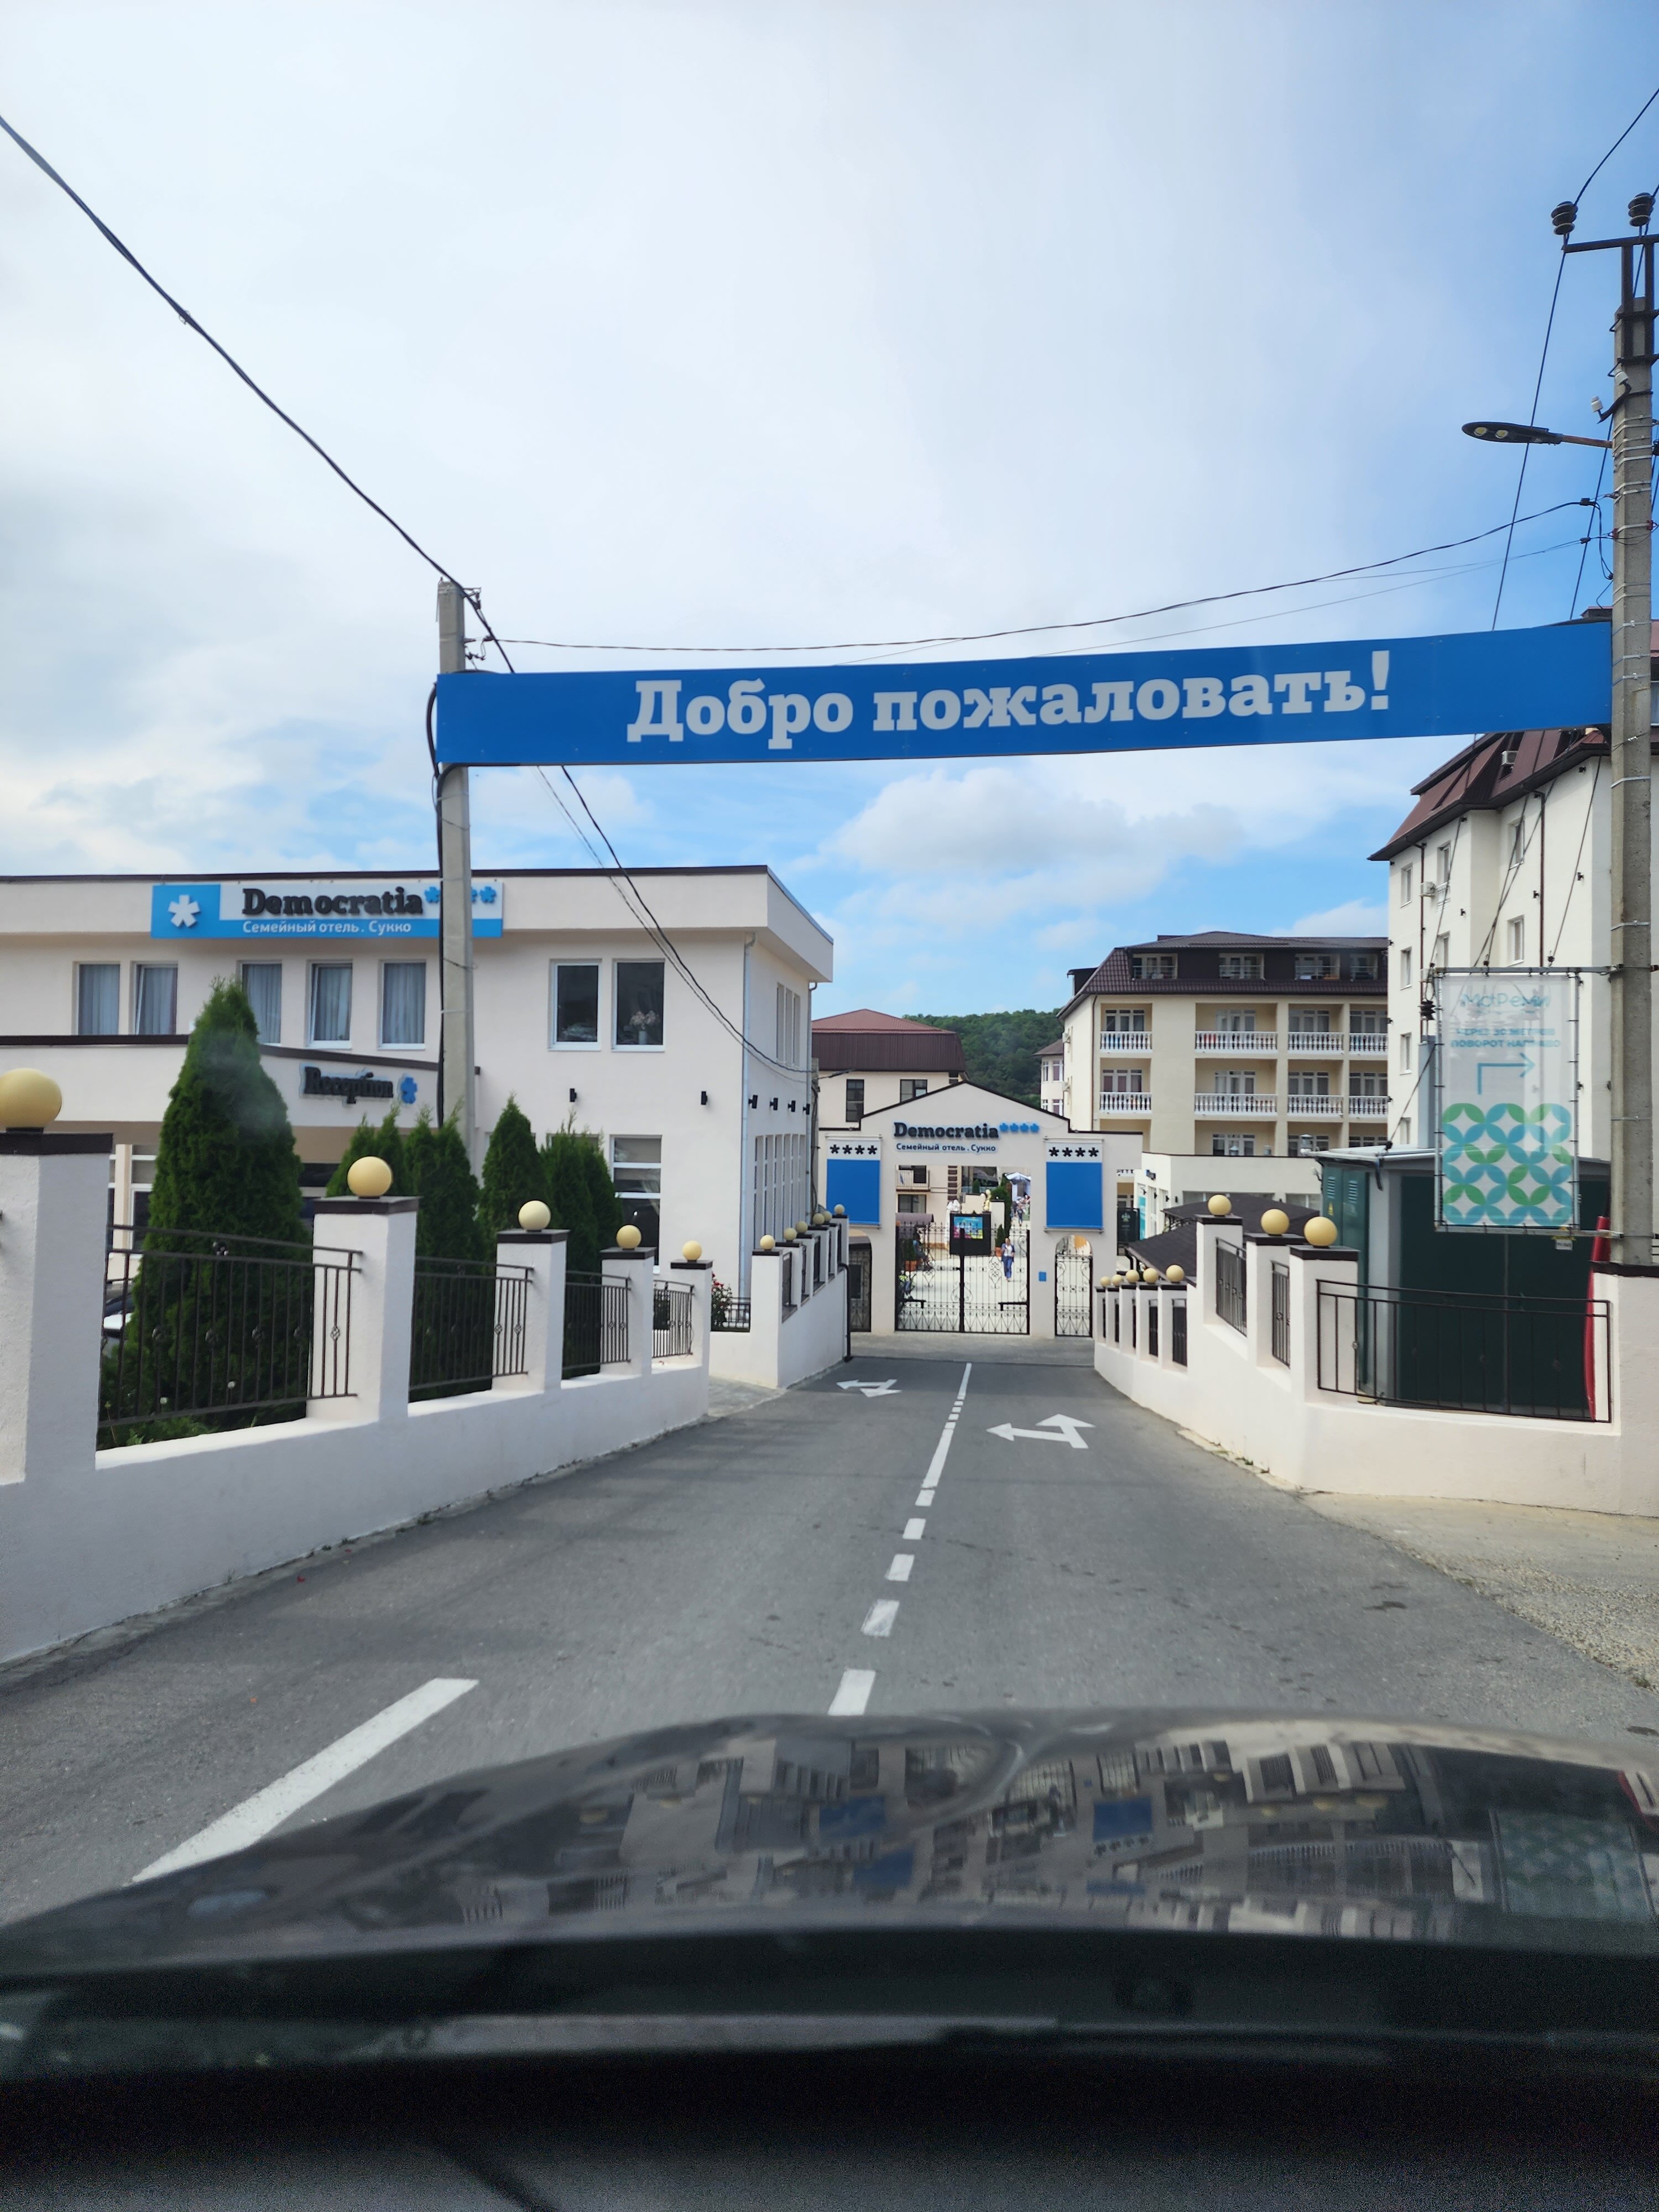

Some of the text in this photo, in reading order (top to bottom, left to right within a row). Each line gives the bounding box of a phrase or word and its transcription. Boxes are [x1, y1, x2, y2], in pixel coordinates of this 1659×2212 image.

[627, 649, 1390, 749] Добро пожаловать!
[242, 886, 423, 916] Democratia
[243, 920, 316, 933] Семейный
[368, 921, 411, 936] Сукко
[1451, 1039, 1505, 1047] ПОВОРОТ
[304, 1066, 394, 1104] Reception
[894, 1122, 1000, 1139] Democratia
[896, 1142, 940, 1151] Семейный
[971, 1144, 997, 1153] Сукко
